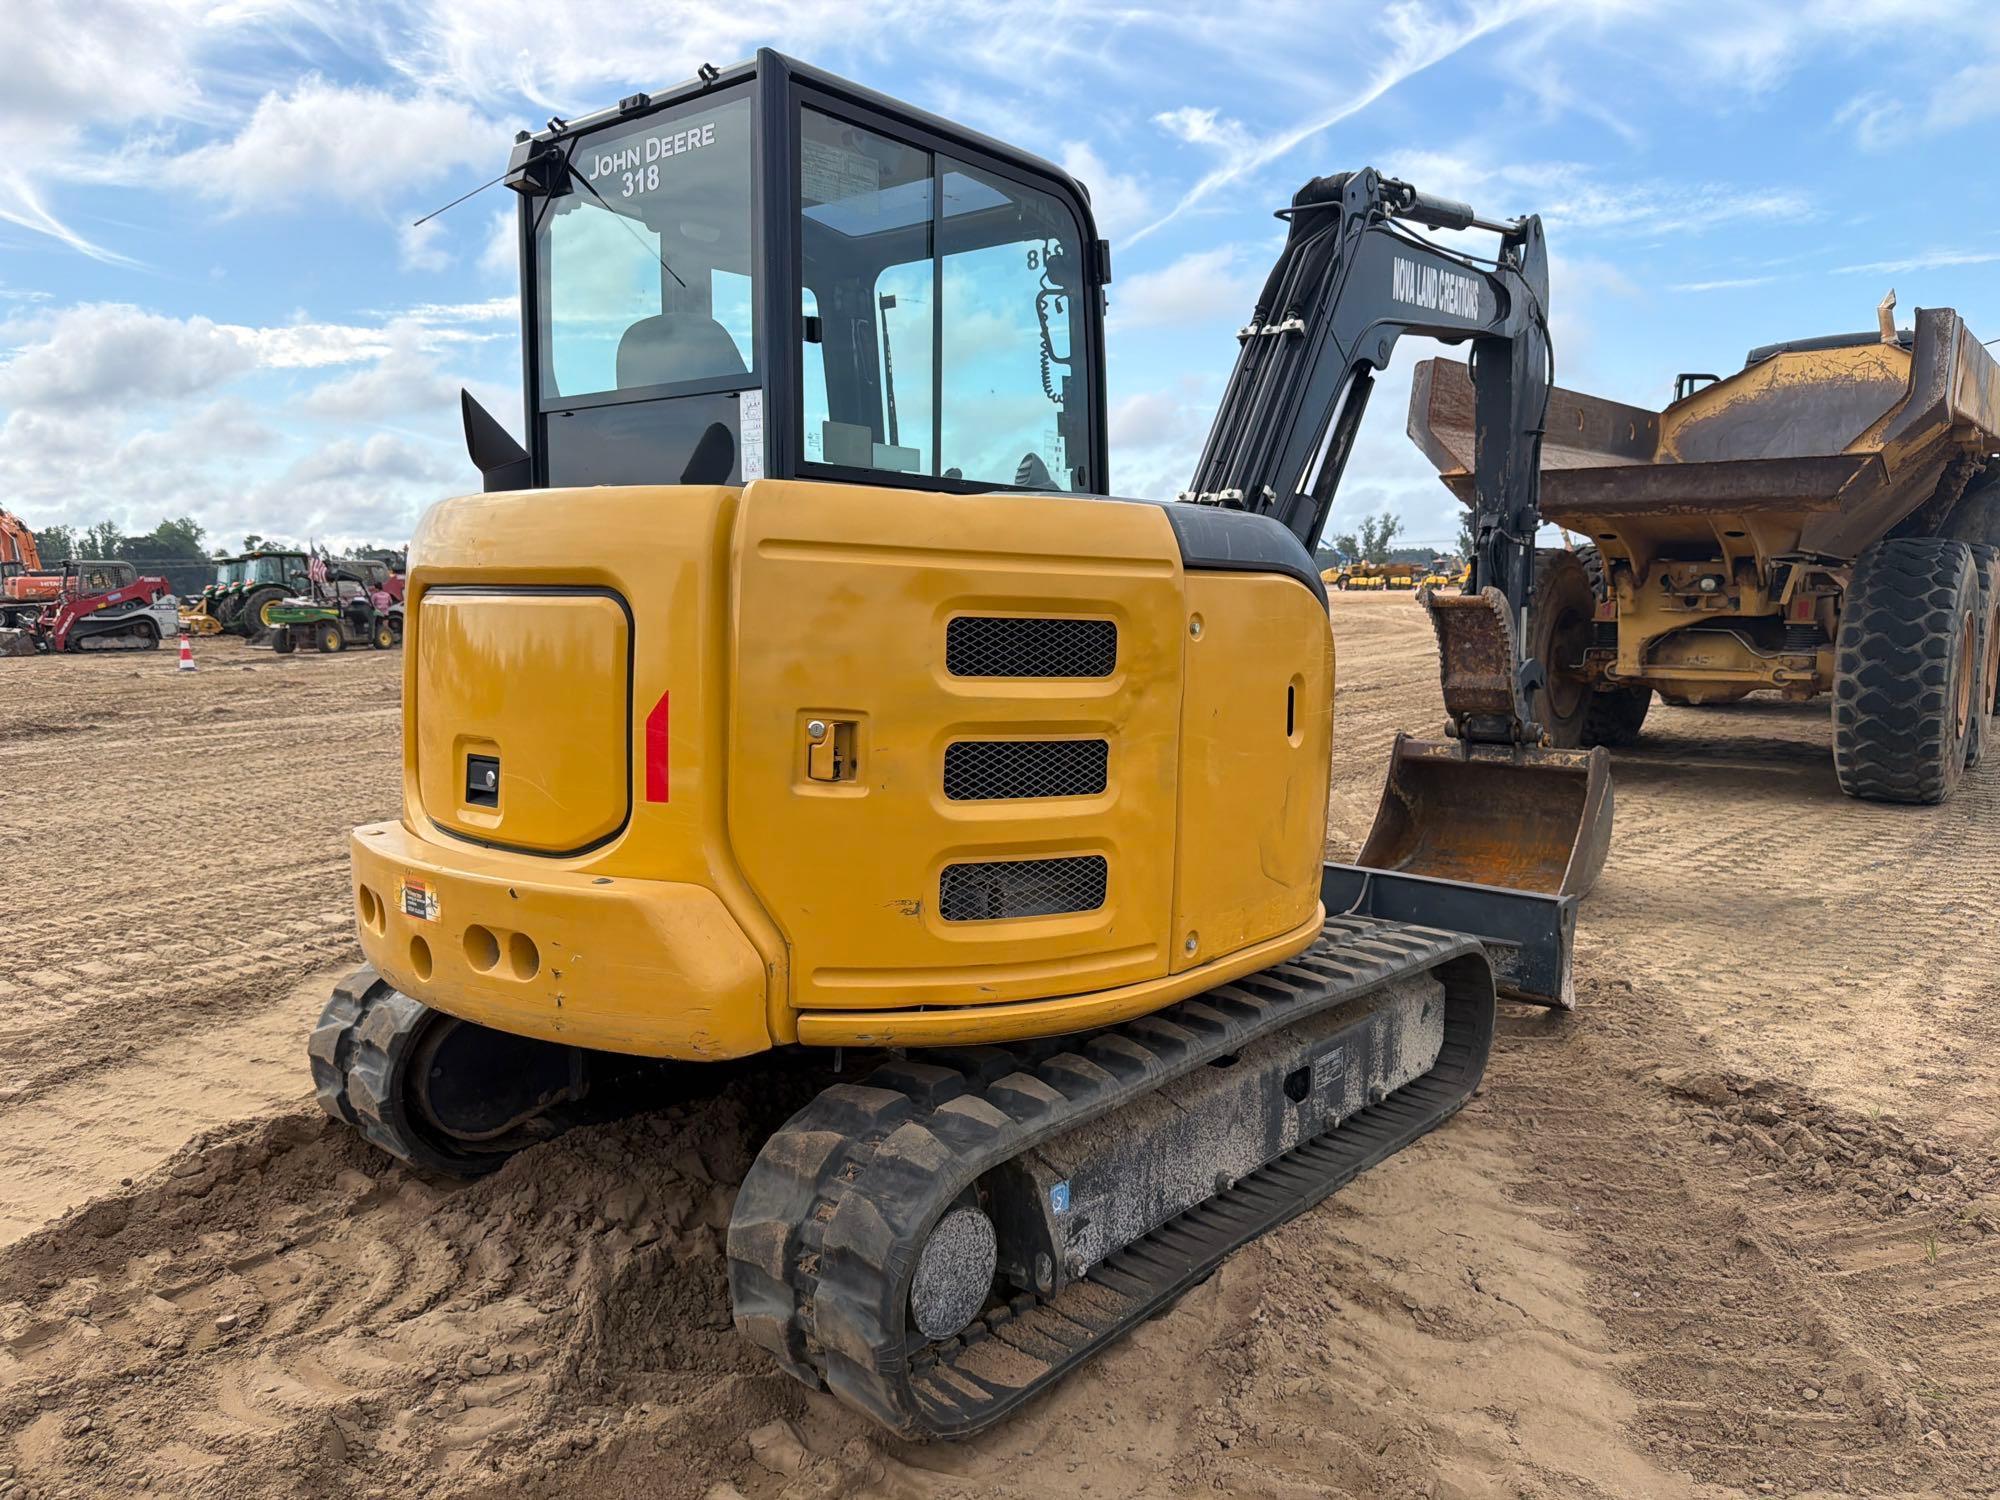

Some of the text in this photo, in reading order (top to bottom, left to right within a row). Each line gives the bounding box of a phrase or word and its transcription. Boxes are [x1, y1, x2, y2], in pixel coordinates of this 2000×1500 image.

[589, 123, 715, 181] JOHN DEERE
[622, 165, 660, 198] 318
[1392, 256, 1480, 320] NOVA LAND CREATIONS
